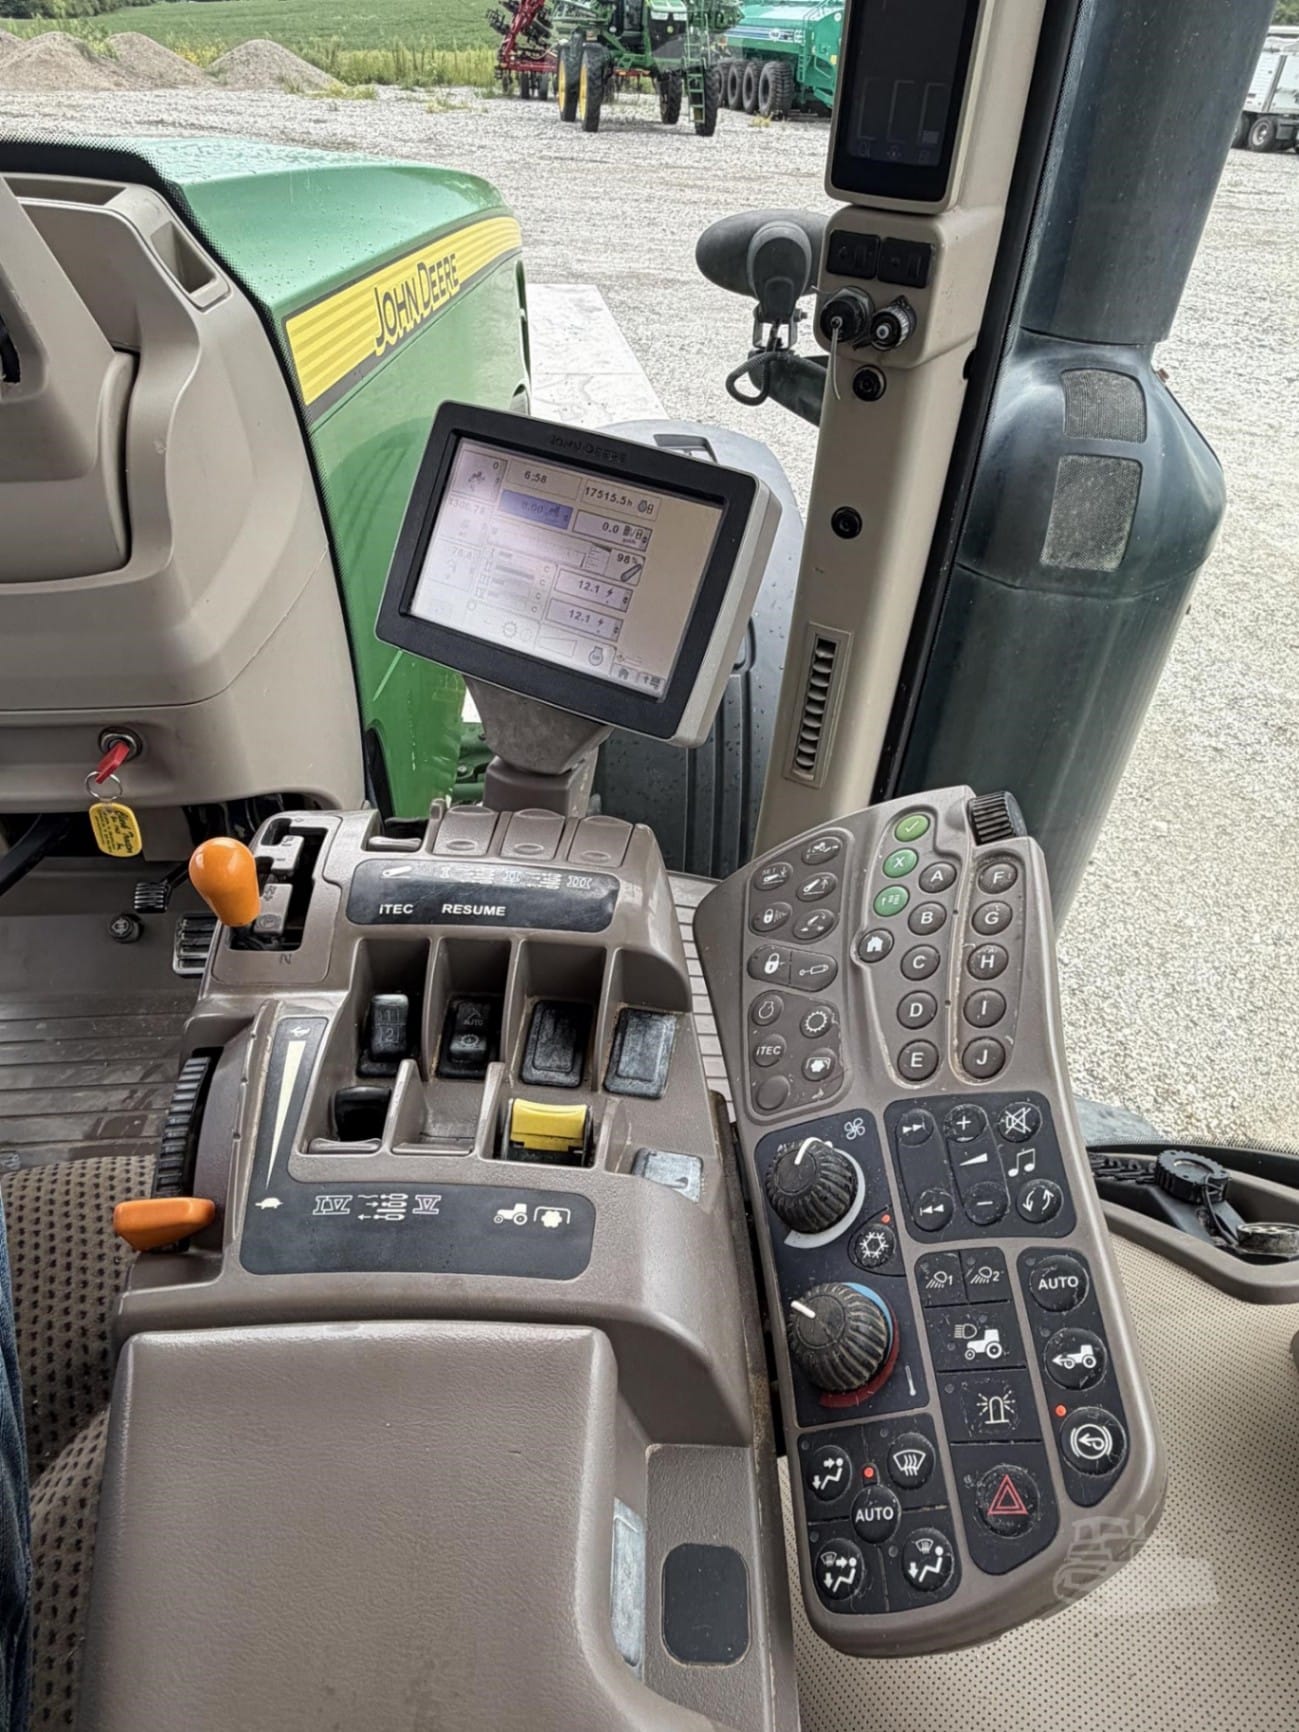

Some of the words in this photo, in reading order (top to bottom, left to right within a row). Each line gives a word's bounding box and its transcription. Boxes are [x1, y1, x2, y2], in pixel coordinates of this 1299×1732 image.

[374, 277, 420, 348] JOHN
[417, 254, 459, 310] DEERE
[523, 469, 548, 484] 6:58
[601, 520, 620, 535] 0.0
[577, 579, 601, 595] 12.1
[567, 608, 592, 624] 12.1
[931, 869, 944, 883] A
[992, 871, 1005, 884] F
[441, 903, 507, 917] RESUME
[920, 911, 934, 925] B
[985, 911, 999, 925] G
[912, 955, 926, 969] C
[980, 955, 994, 969] H
[910, 1003, 923, 1017] D
[911, 1052, 923, 1067] E
[976, 1049, 988, 1065] J
[992, 1268, 1000, 1282] 2
[1037, 1275, 1080, 1291] AUTO
[855, 1506, 894, 1522] AUTO
